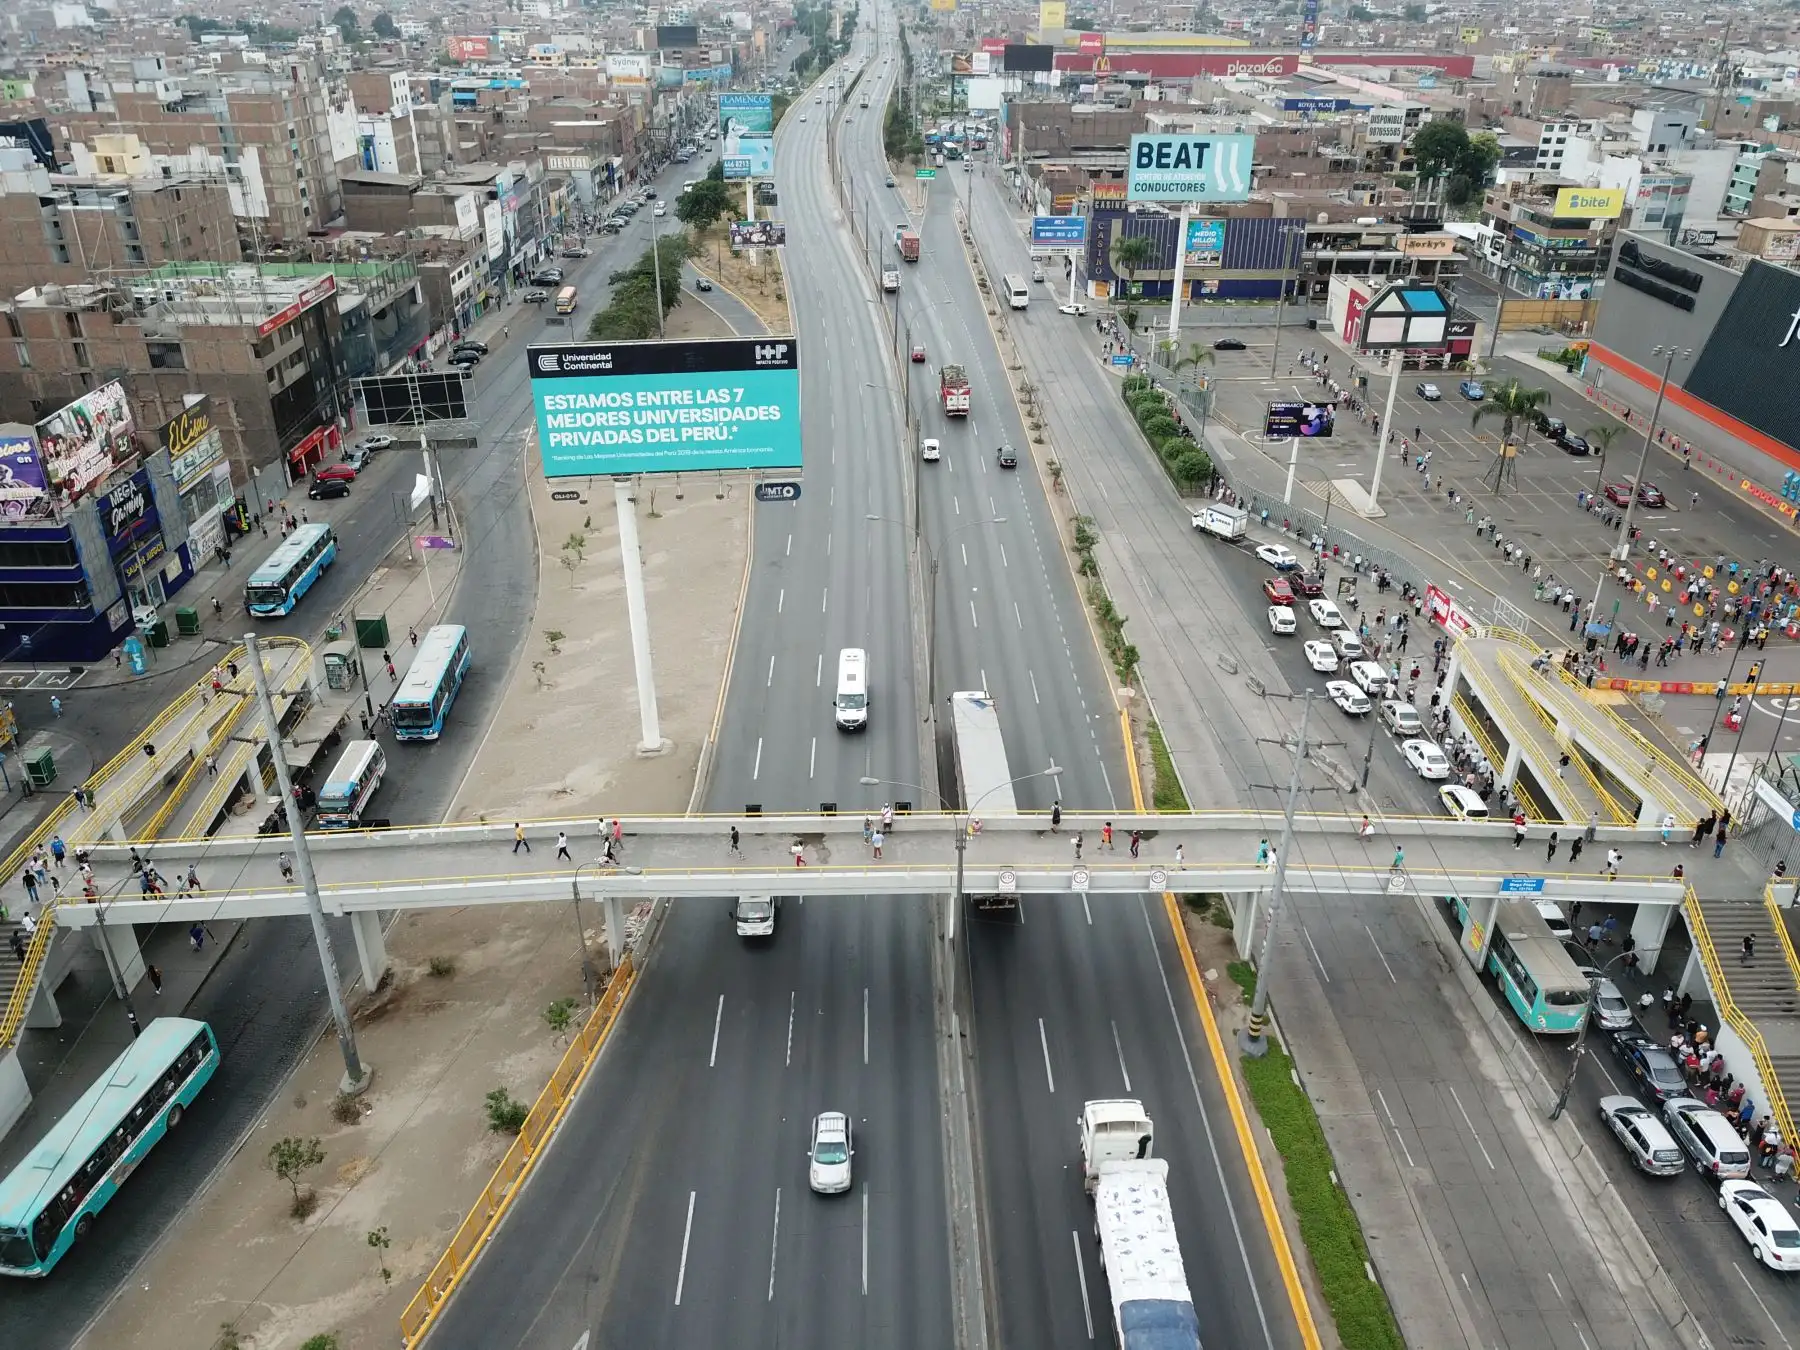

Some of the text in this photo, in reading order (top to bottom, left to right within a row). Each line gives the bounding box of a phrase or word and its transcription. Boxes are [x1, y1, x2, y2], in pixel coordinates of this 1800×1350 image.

[612, 58, 640, 67] Sydney
[720, 95, 771, 104] FLAMENCOS
[1370, 114, 1404, 124] DISPONIBLE
[1136, 142, 1210, 169] BEAT
[550, 157, 588, 169] DENTAL
[1134, 182, 1206, 192] CONDUCTORES
[1580, 197, 1610, 208] bitel
[562, 353, 612, 362] Universidad
[563, 361, 613, 371] Continental
[543, 387, 745, 410] ESTAMOS ENTRE LAS 7
[546, 405, 781, 428] MEJORES UNIVERSIDADES
[549, 428, 644, 447] PRIVADAS
[646, 427, 679, 443] DEL
[109, 479, 137, 508] MEGA
